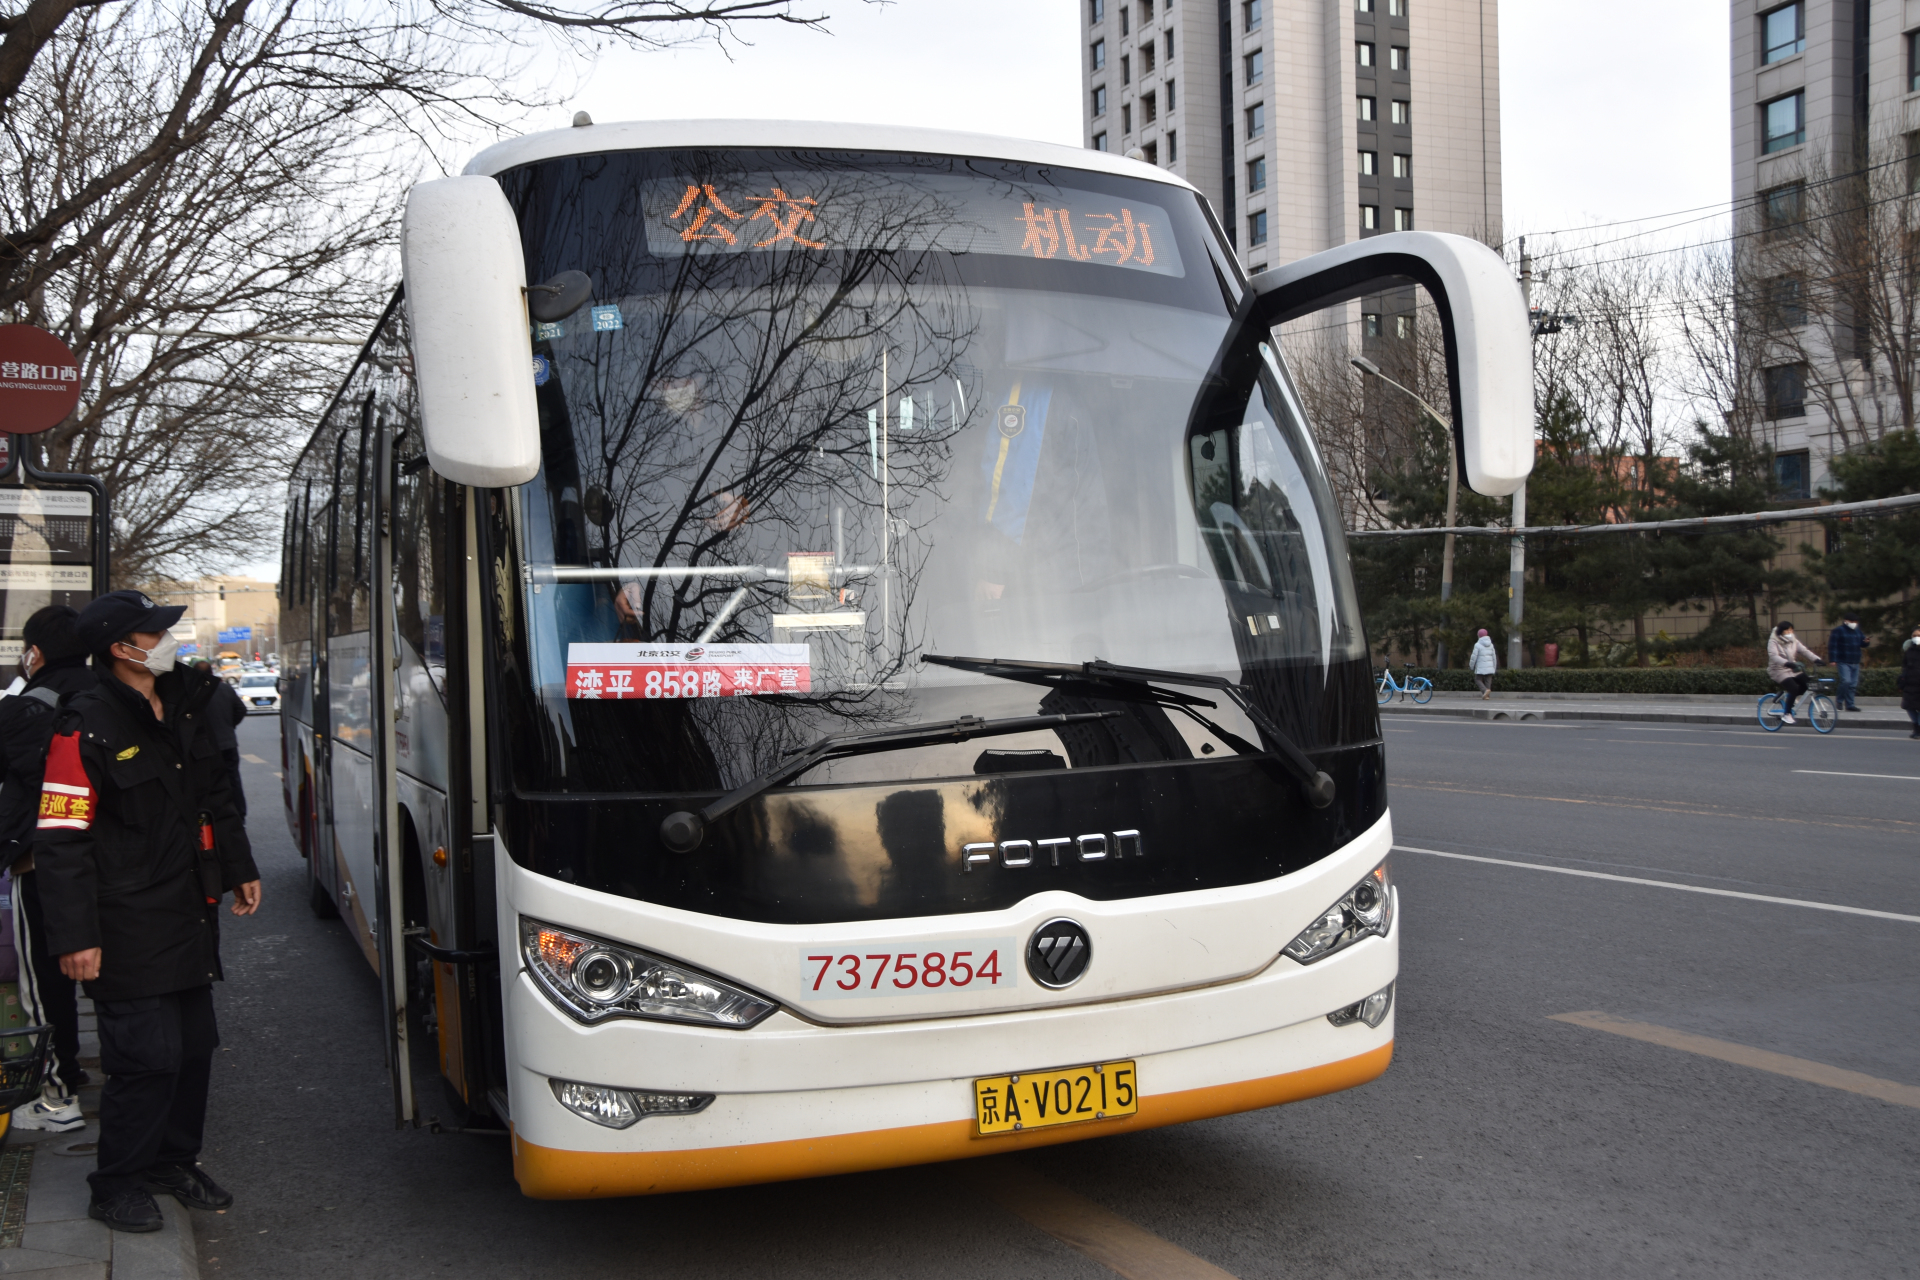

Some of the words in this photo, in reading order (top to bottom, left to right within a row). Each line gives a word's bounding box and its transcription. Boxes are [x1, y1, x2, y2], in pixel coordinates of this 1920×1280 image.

[670, 184, 826, 250] 公交
[1014, 202, 1155, 266] 机动
[597, 320, 620, 330] 2022
[1, 361, 77, 381] 营路口西
[733, 668, 799, 688] 来广营
[962, 829, 1144, 872] FOTON
[807, 949, 1003, 991] 7375854
